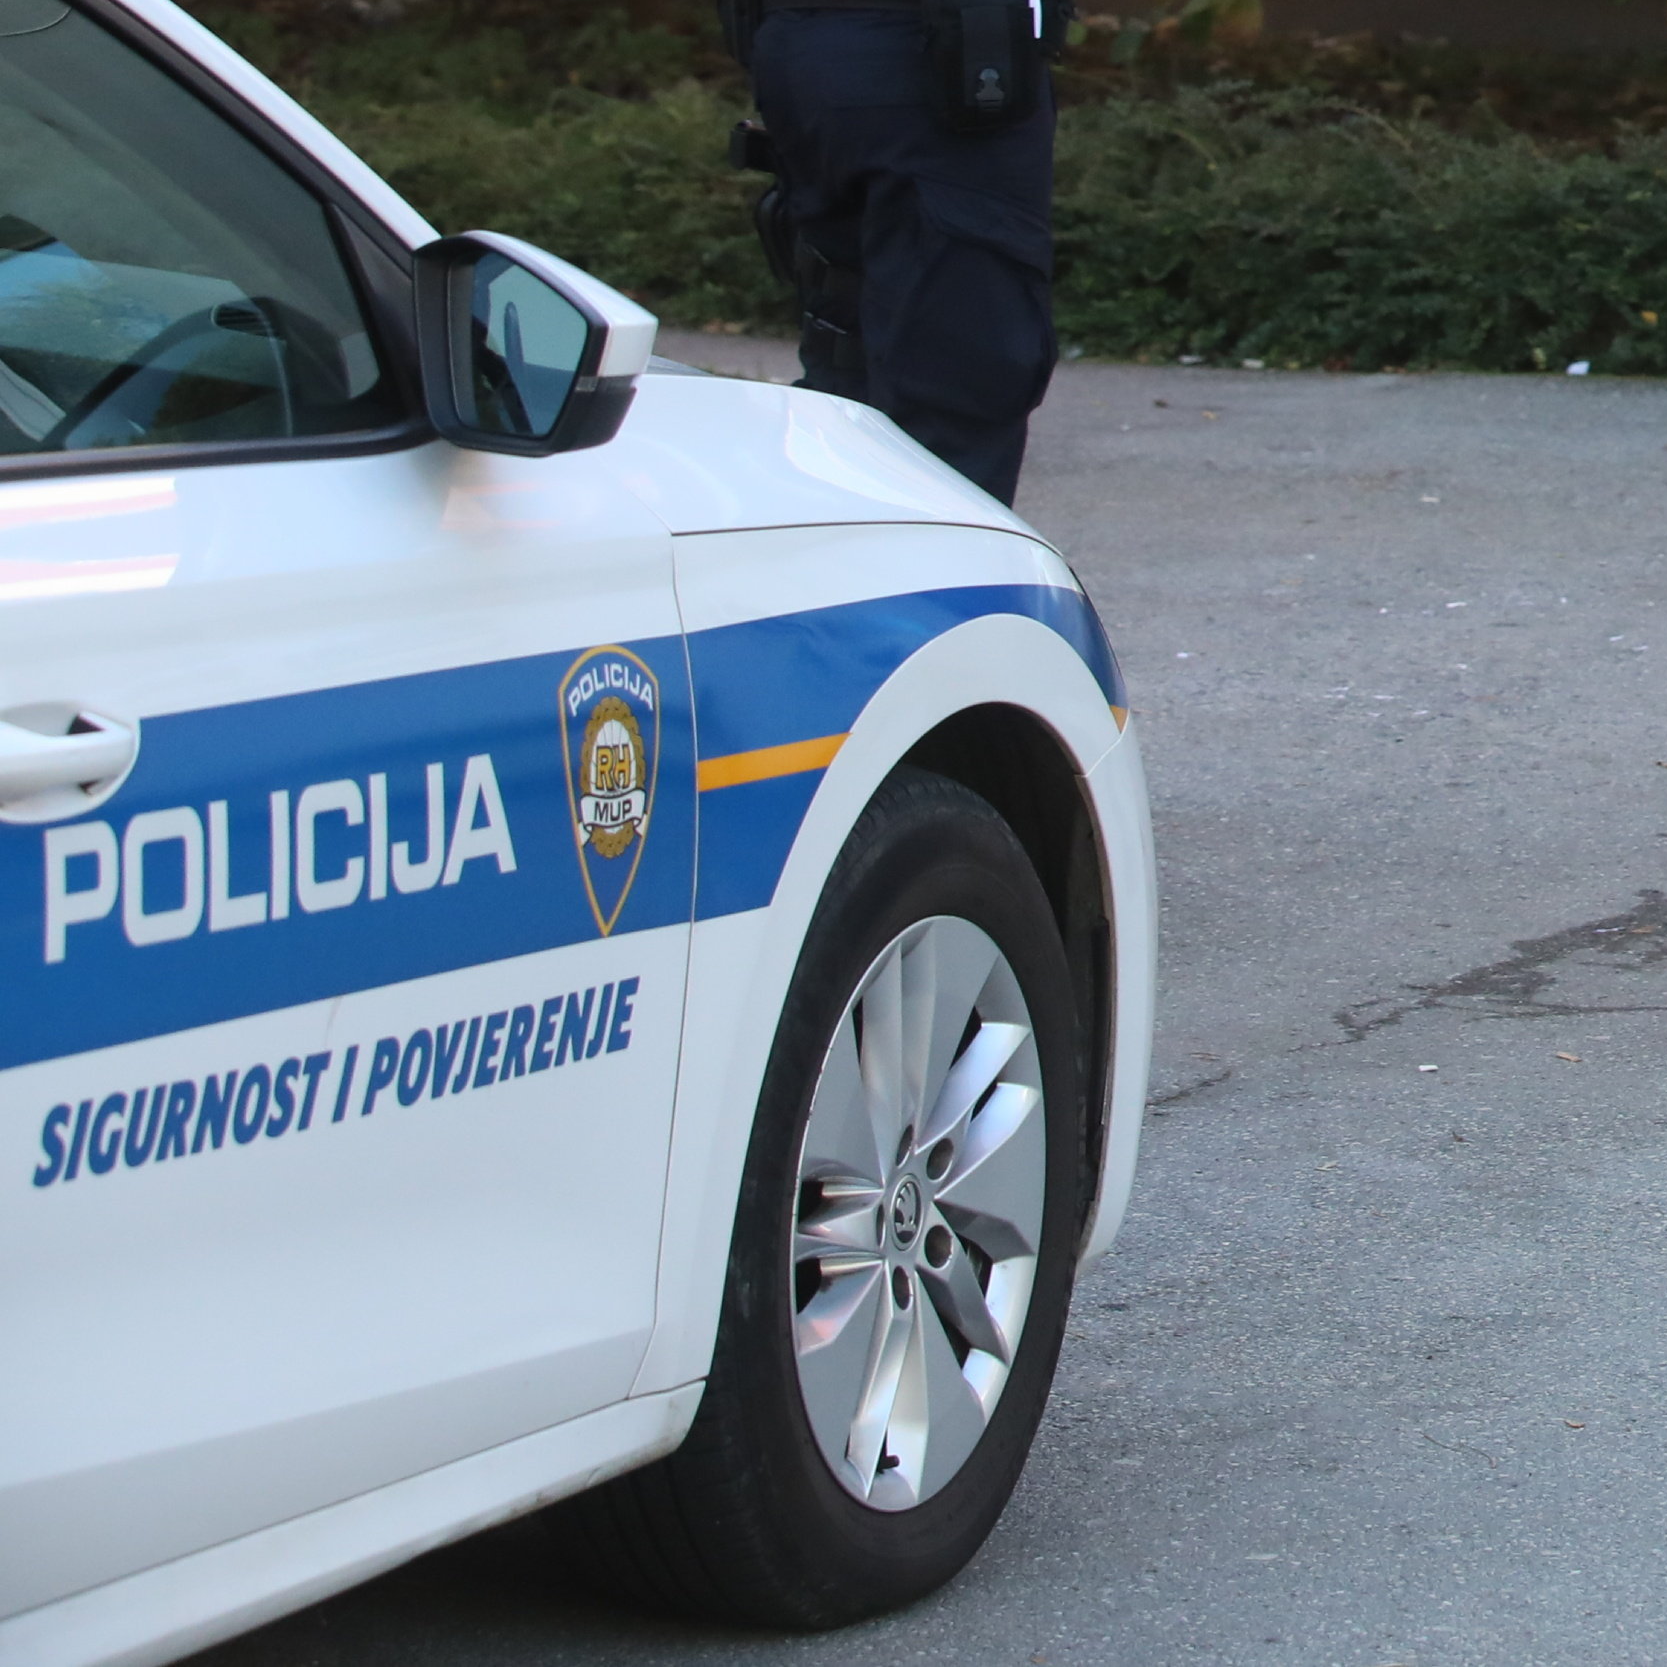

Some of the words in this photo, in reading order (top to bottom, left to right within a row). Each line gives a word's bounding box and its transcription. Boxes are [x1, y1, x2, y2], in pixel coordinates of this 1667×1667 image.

[568, 663, 655, 717] POLICIJA
[596, 742, 631, 791] RH
[594, 799, 632, 824] MUP
[44, 752, 518, 965] POLICIJA
[32, 1050, 331, 1188] SIGURNOST
[331, 1044, 361, 1123] I
[361, 975, 641, 1116] POVJERENJE
